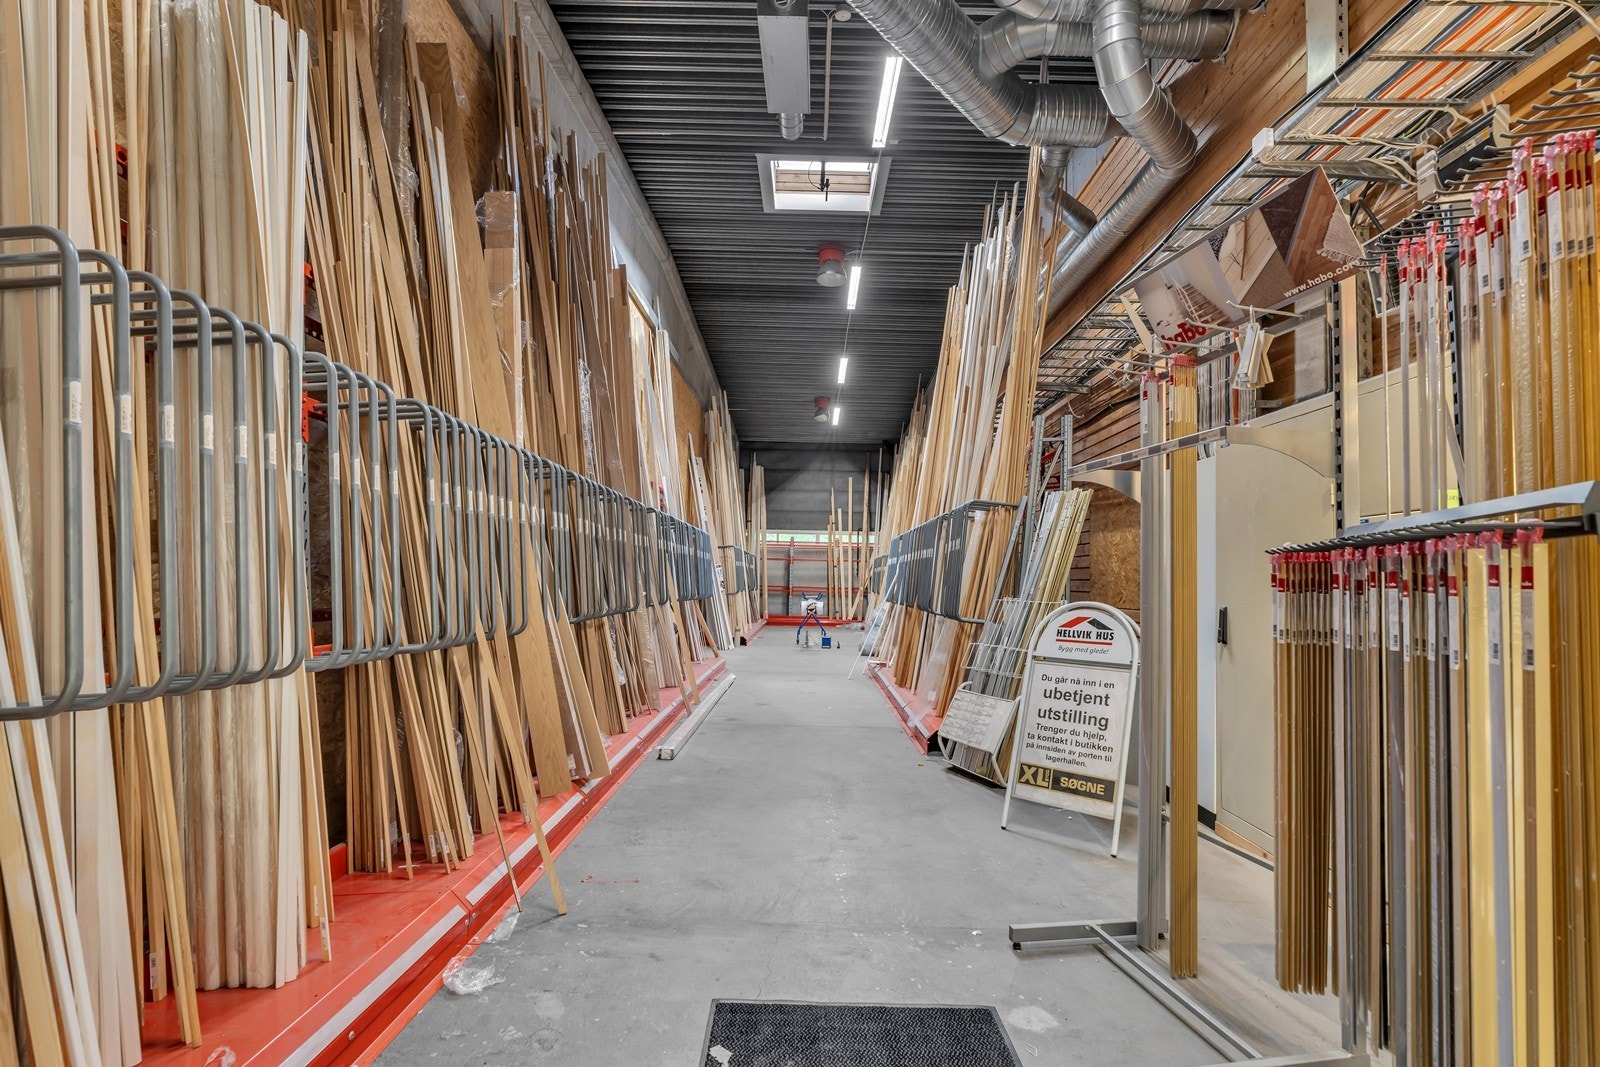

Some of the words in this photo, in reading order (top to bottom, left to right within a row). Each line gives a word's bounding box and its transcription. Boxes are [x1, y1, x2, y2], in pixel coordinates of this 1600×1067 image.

[1283, 260, 1360, 298] www.habo.com
[1160, 321, 1207, 351] habo
[1056, 629, 1092, 639] HELLVIK
[1095, 631, 1115, 641] HUS
[1058, 644, 1073, 653] Bygg
[1089, 647, 1110, 655] glede!
[1041, 673, 1053, 682] Du
[1054, 675, 1068, 684] går
[1070, 677, 1081, 685] nå
[1083, 678, 1097, 687] inn
[1043, 686, 1110, 706] ubetjent
[1037, 707, 1109, 731] utstilling
[1036, 722, 1068, 735] Trenger
[1069, 729, 1081, 737] du
[1083, 730, 1107, 742] hjelp,
[1026, 741, 1035, 749] på
[1036, 743, 1066, 754] innsiden
[1078, 751, 1103, 761] porten
[1104, 754, 1113, 762] til
[1027, 732, 1035, 740] ta
[1037, 733, 1068, 745] kontakt
[1075, 739, 1114, 753] butikken
[1045, 753, 1088, 768] lagerhallen.
[1019, 764, 1049, 788] XL
[1060, 776, 1106, 796] SØGNE
